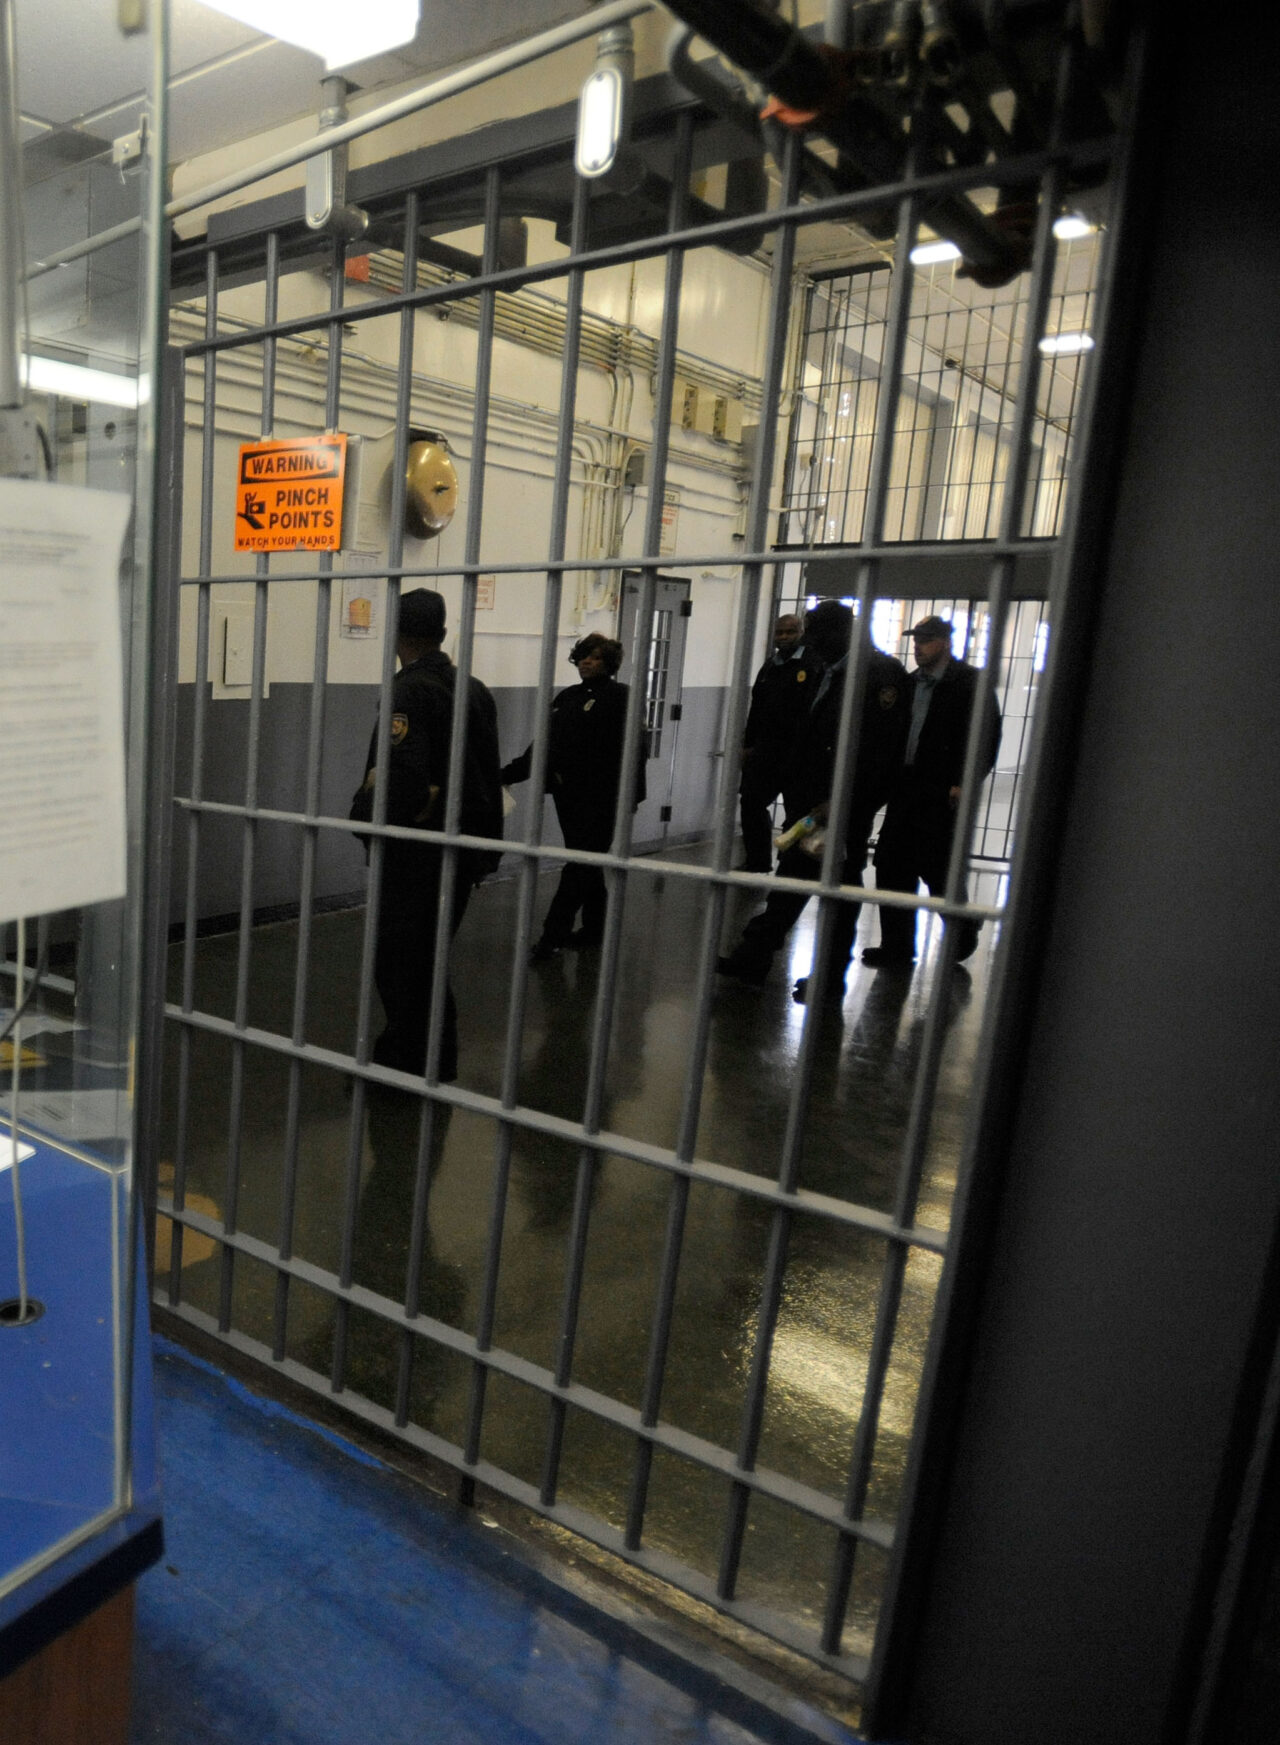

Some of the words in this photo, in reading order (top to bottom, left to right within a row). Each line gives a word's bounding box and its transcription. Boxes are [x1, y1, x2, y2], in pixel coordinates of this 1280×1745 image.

[252, 455, 328, 475] WARNING
[276, 488, 329, 507] PINCH
[269, 510, 335, 529] POINTS
[238, 538, 269, 547] WATCH
[272, 536, 297, 546] YOUR
[300, 535, 335, 545] HANDS
